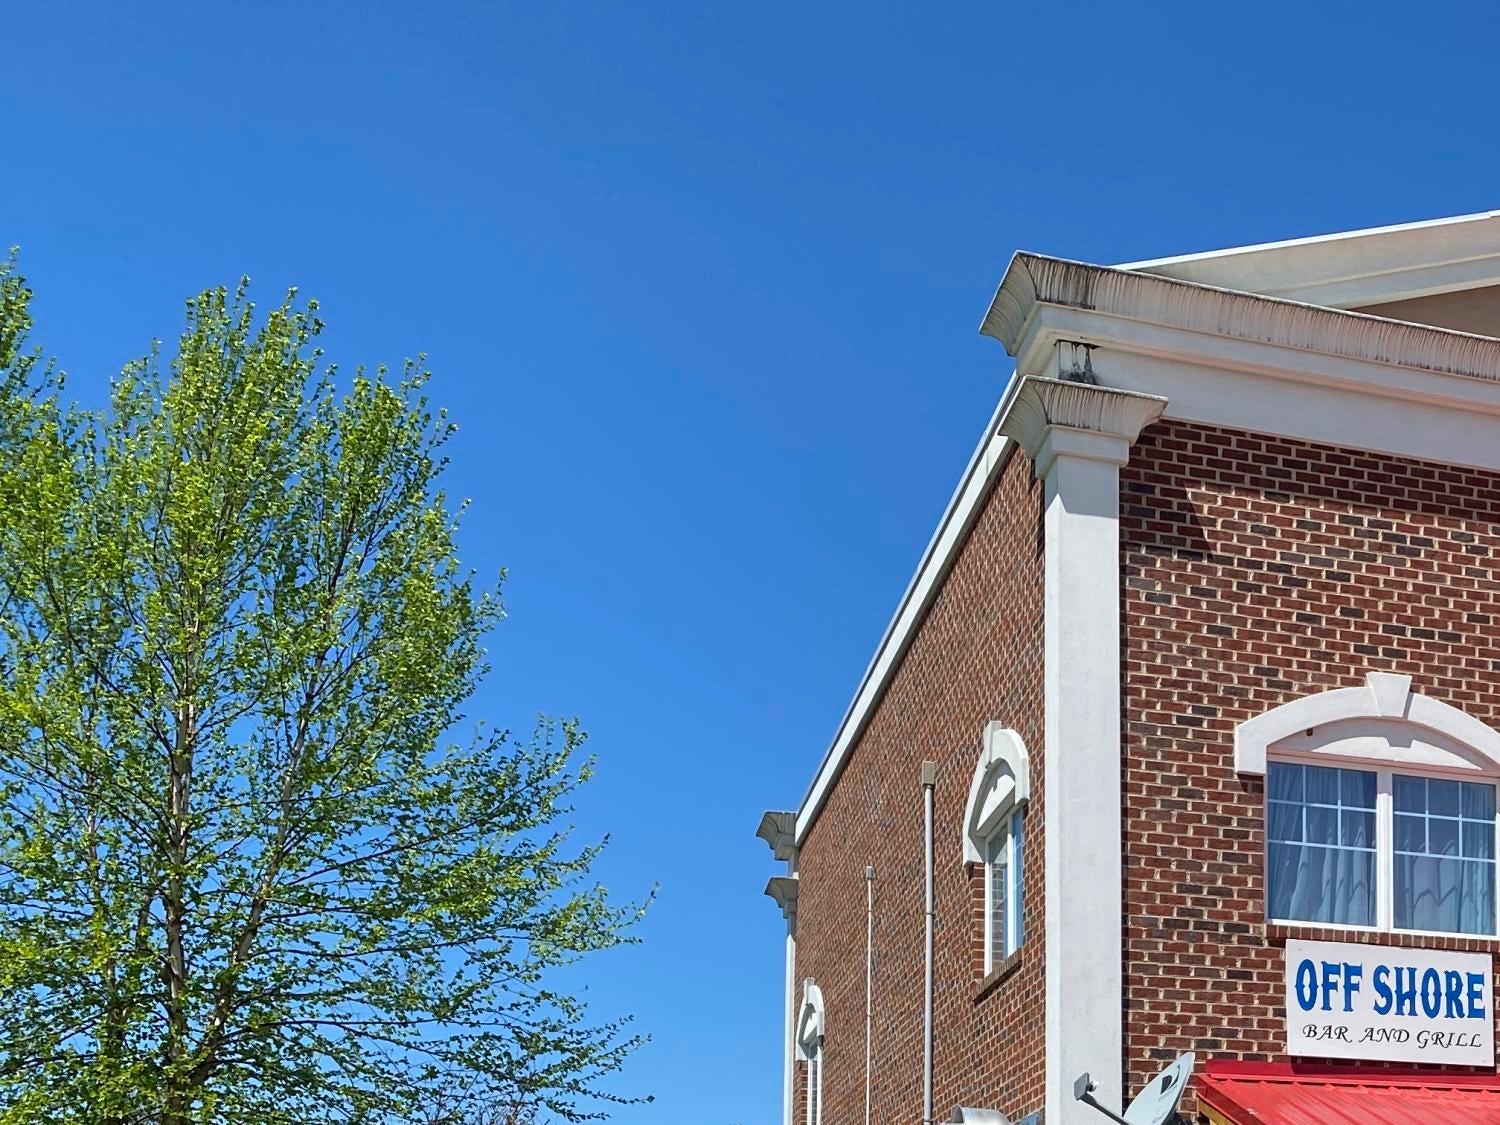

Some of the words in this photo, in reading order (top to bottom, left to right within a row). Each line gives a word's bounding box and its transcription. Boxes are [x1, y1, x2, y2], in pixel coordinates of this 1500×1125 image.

[1295, 958, 1363, 1012] OFF
[1372, 964, 1486, 1021] SHORE
[1302, 1024, 1352, 1043] BAR
[1359, 1027, 1410, 1043] AND
[1416, 1030, 1482, 1049] GRILL
